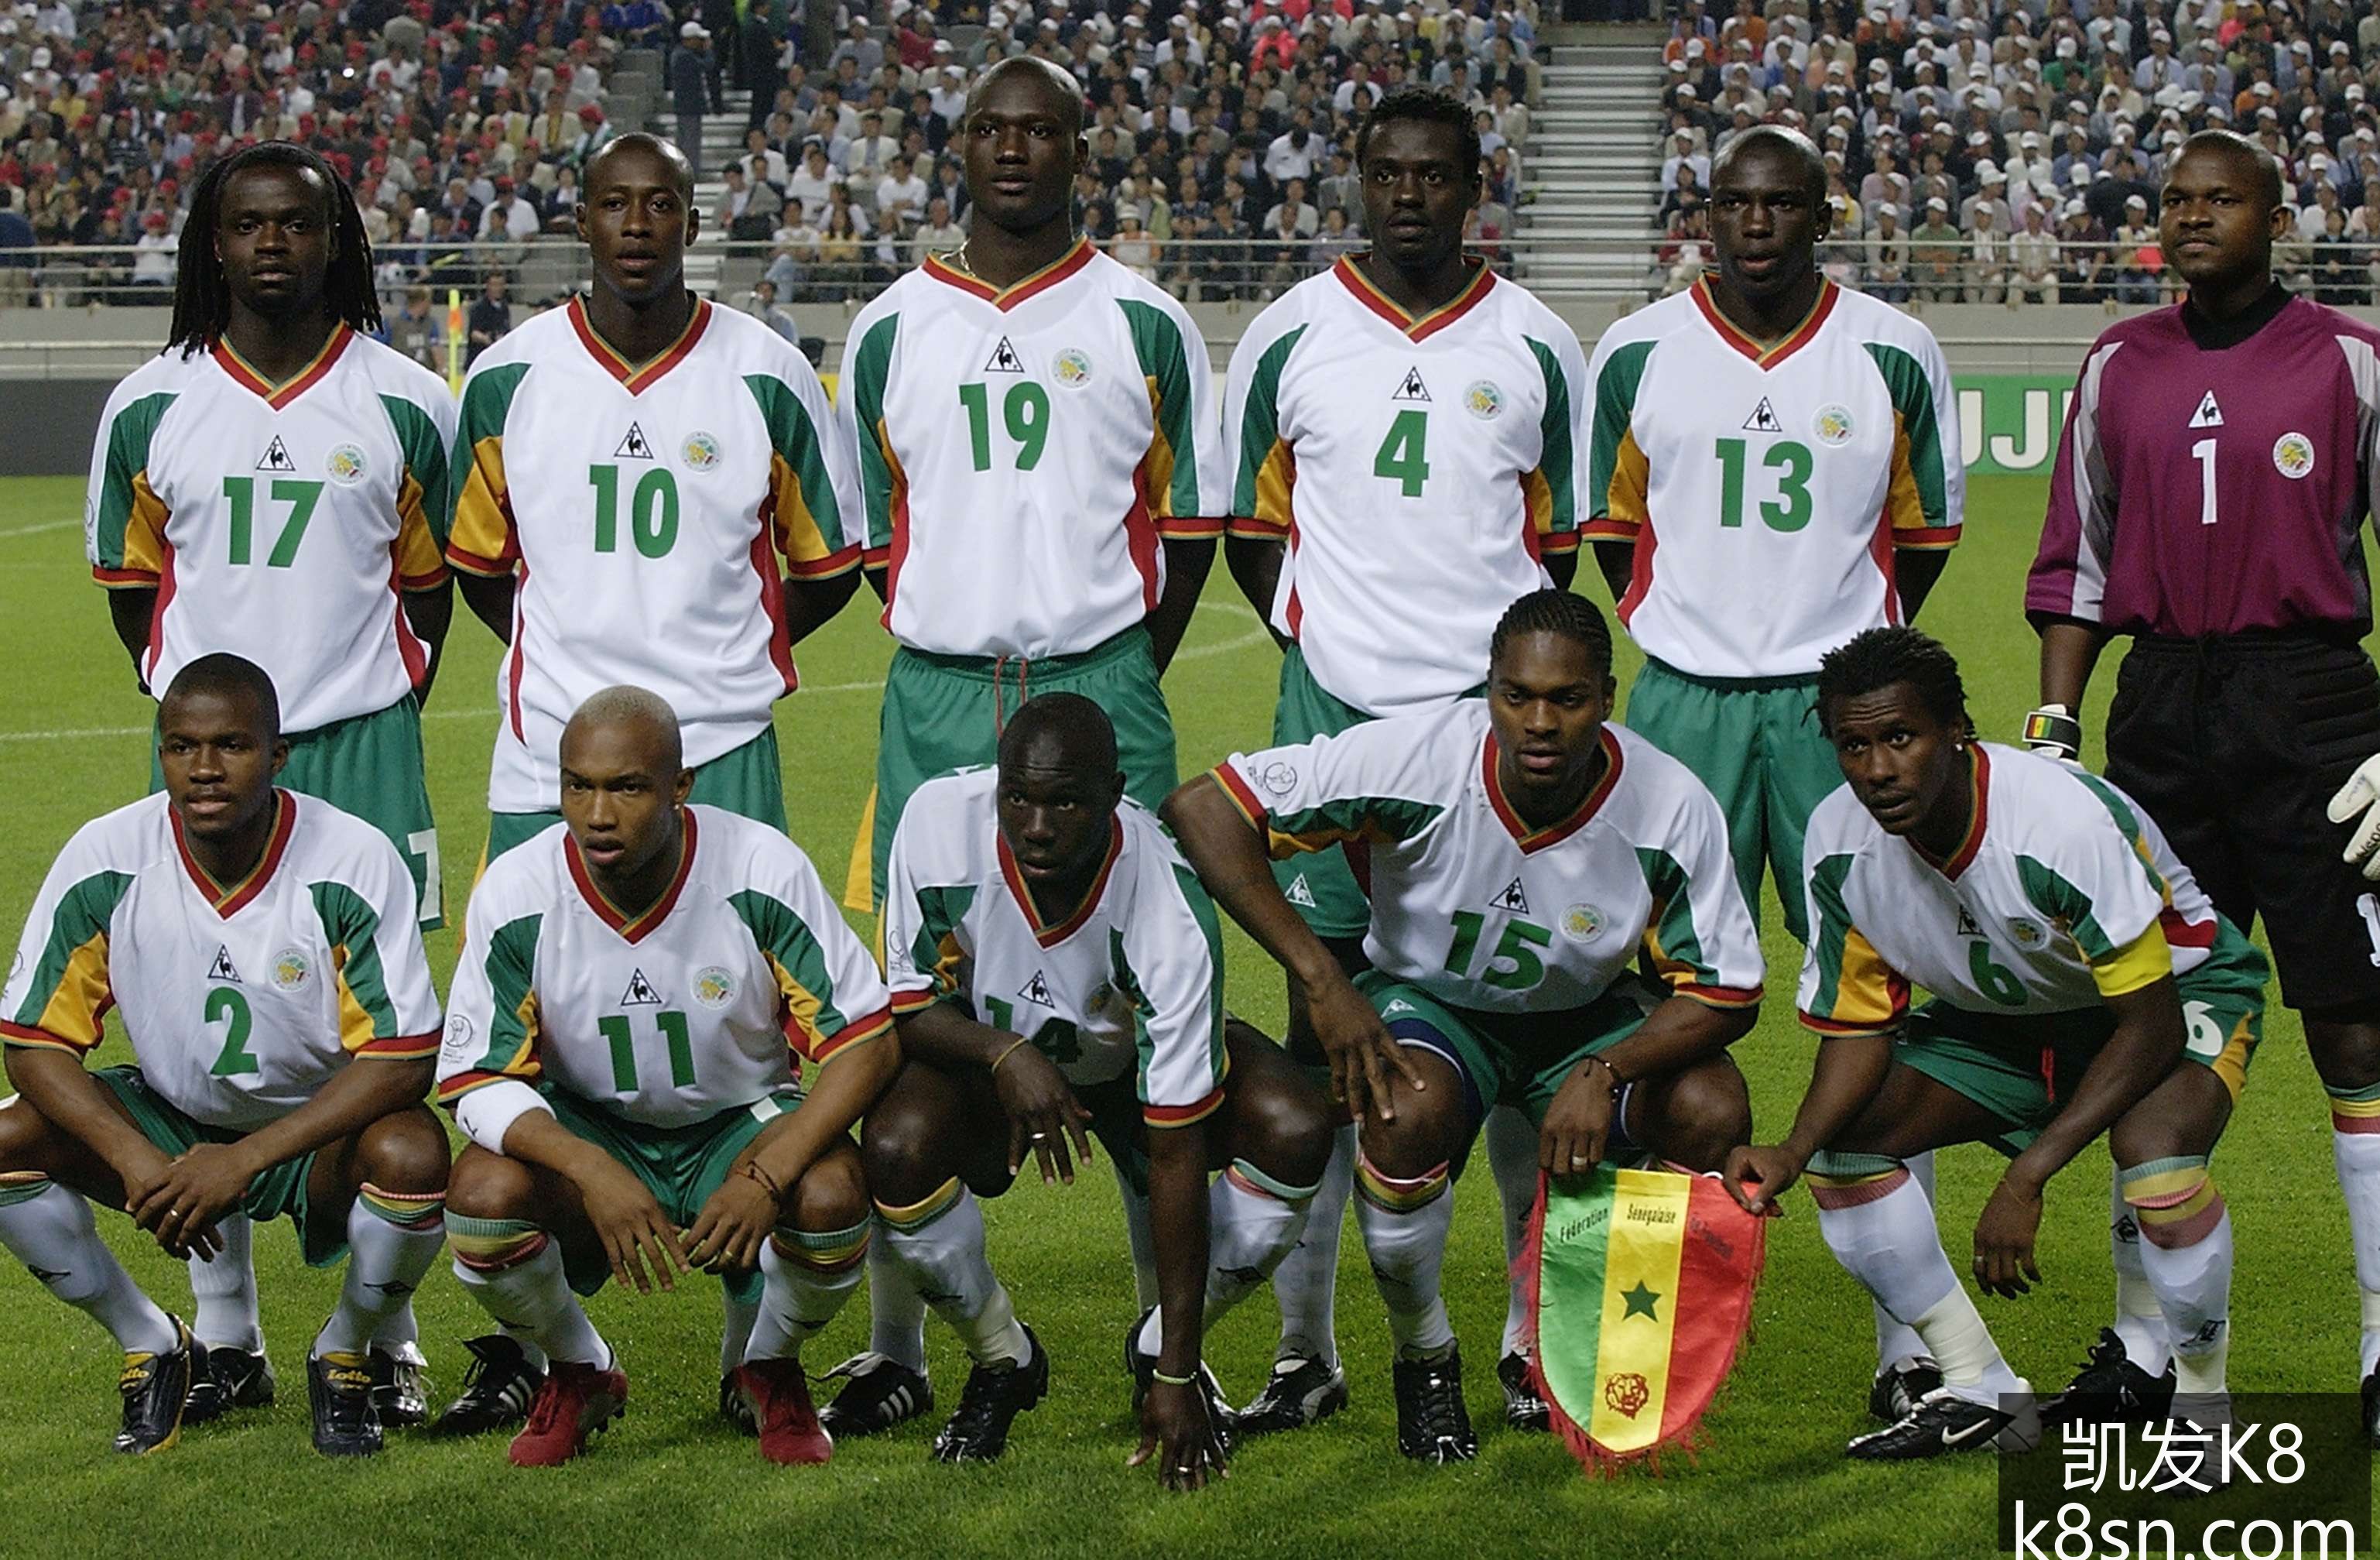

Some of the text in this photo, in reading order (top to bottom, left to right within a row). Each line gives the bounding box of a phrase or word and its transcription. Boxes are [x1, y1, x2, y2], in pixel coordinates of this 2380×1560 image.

[959, 382, 1050, 471] 19
[1374, 410, 1430, 497] 4
[223, 475, 325, 568] 17
[589, 464, 680, 558] 10
[1715, 437, 1813, 533] 13
[2192, 438, 2217, 524] 1
[1443, 910, 1552, 991] 15
[1969, 940, 2029, 1006] 6
[204, 986, 259, 1076] 2
[598, 1010, 696, 1092] 11
[2182, 999, 2224, 1057] 6
